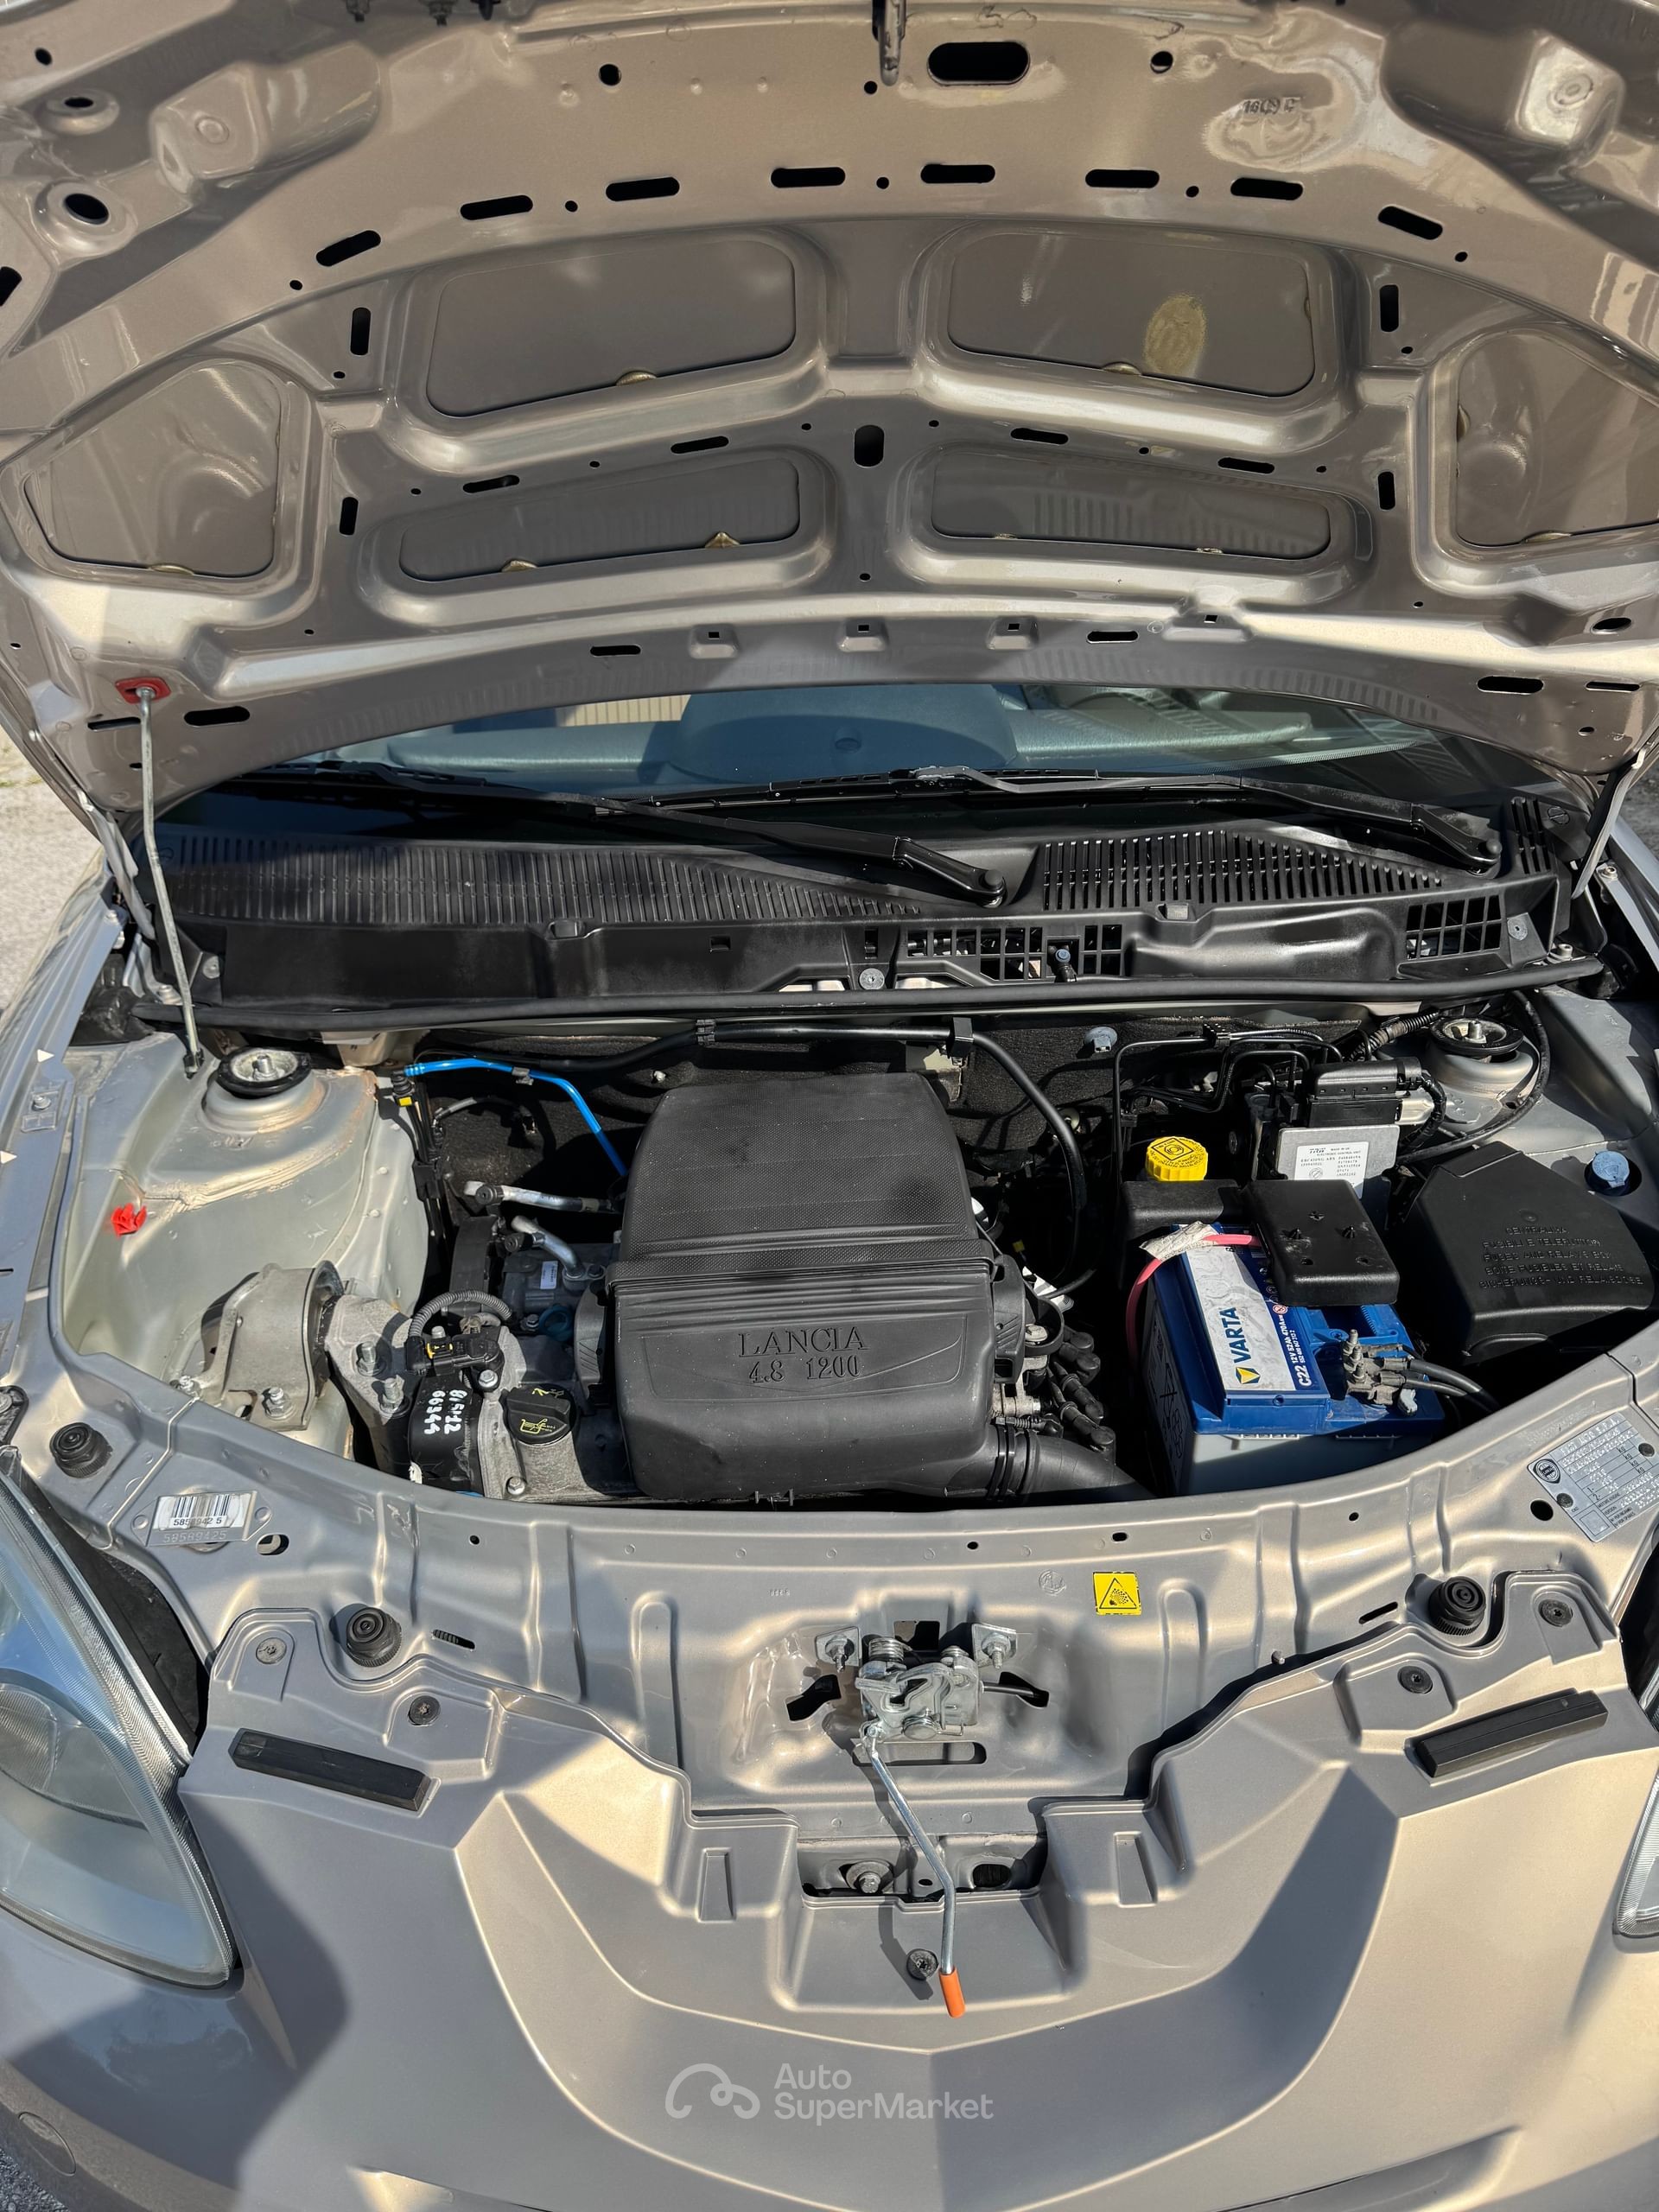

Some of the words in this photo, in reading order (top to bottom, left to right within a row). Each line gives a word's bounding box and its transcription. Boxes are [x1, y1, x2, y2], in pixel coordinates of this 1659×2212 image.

[1527, 1238, 1535, 1247] E
[1483, 1252, 1520, 1262] FUSES
[1523, 1250, 1544, 1259] AND
[1518, 1262, 1568, 1273] FUSIBLES
[1571, 1262, 1583, 1271] ET
[738, 1326, 869, 1357] LANCIA
[1219, 1306, 1252, 1363] VARTA
[1284, 1336, 1294, 1352] 52Ah
[1289, 1351, 1299, 1363] 12V
[806, 1355, 861, 1380] 1200
[1294, 1364, 1313, 1387] C22
